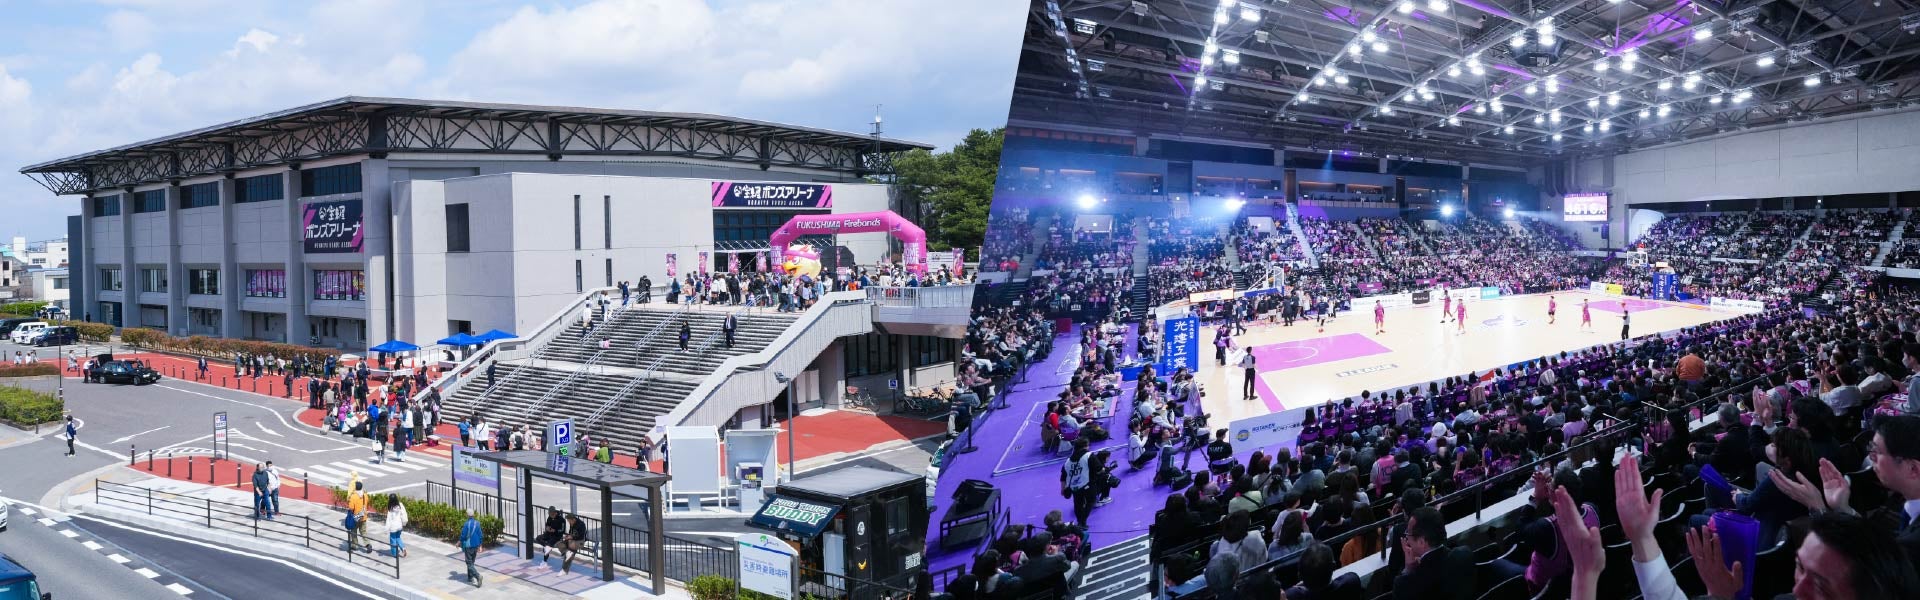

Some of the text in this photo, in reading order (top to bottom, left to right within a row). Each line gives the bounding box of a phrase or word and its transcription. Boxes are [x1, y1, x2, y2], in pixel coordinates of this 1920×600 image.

[762, 185, 815, 200] ボンズアリーナ
[305, 221, 361, 239] ボンズアリーナ
[796, 220, 841, 229] FUKUSHIMA
[843, 218, 881, 228] Firebonds
[1173, 320, 1188, 369] 光建工業
[557, 425, 568, 444] P
[762, 503, 828, 525] BUDDY
